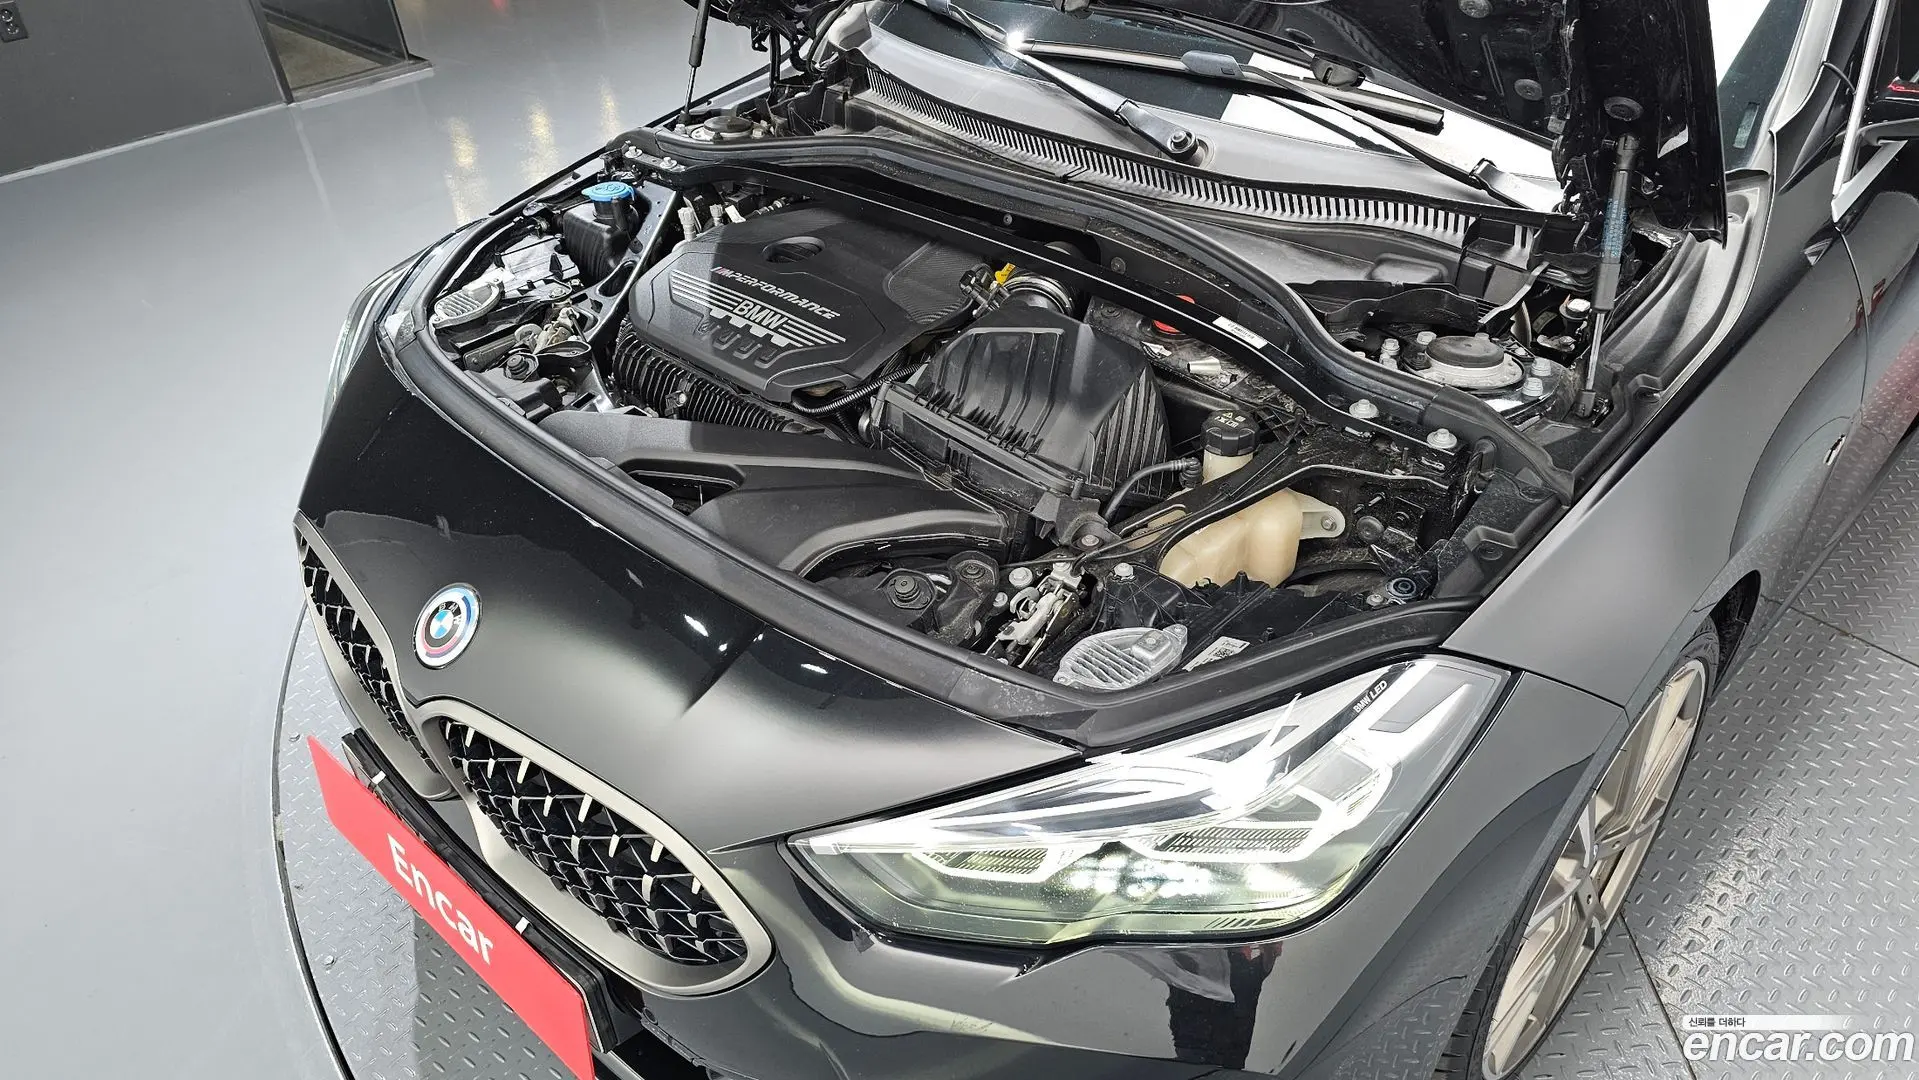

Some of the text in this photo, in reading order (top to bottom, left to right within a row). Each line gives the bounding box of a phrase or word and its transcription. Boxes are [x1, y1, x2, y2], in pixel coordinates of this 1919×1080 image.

[733, 299, 789, 330] BMW
[1353, 680, 1387, 713] BMW LED
[387, 833, 494, 965] Encar
